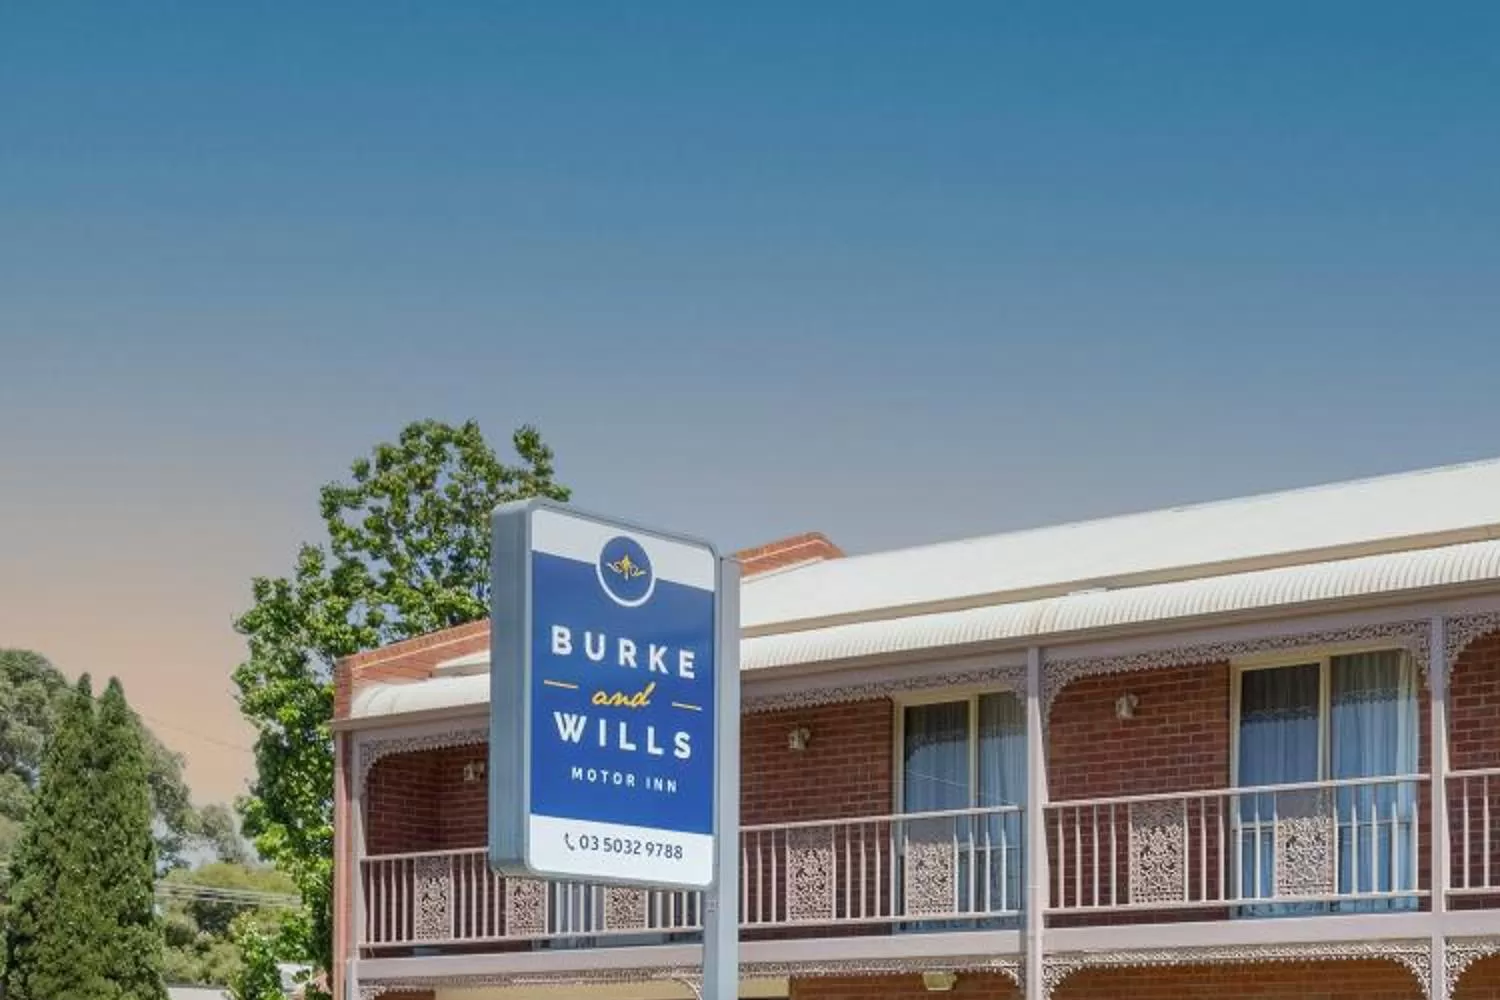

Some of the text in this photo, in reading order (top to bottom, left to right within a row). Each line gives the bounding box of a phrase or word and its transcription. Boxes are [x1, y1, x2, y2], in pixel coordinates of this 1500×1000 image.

[551, 625, 695, 679] BURKE
[591, 682, 656, 708] and
[553, 711, 692, 759] WILLS
[571, 767, 678, 793] MOTOR INN
[579, 834, 683, 859] 03 5032 9788
